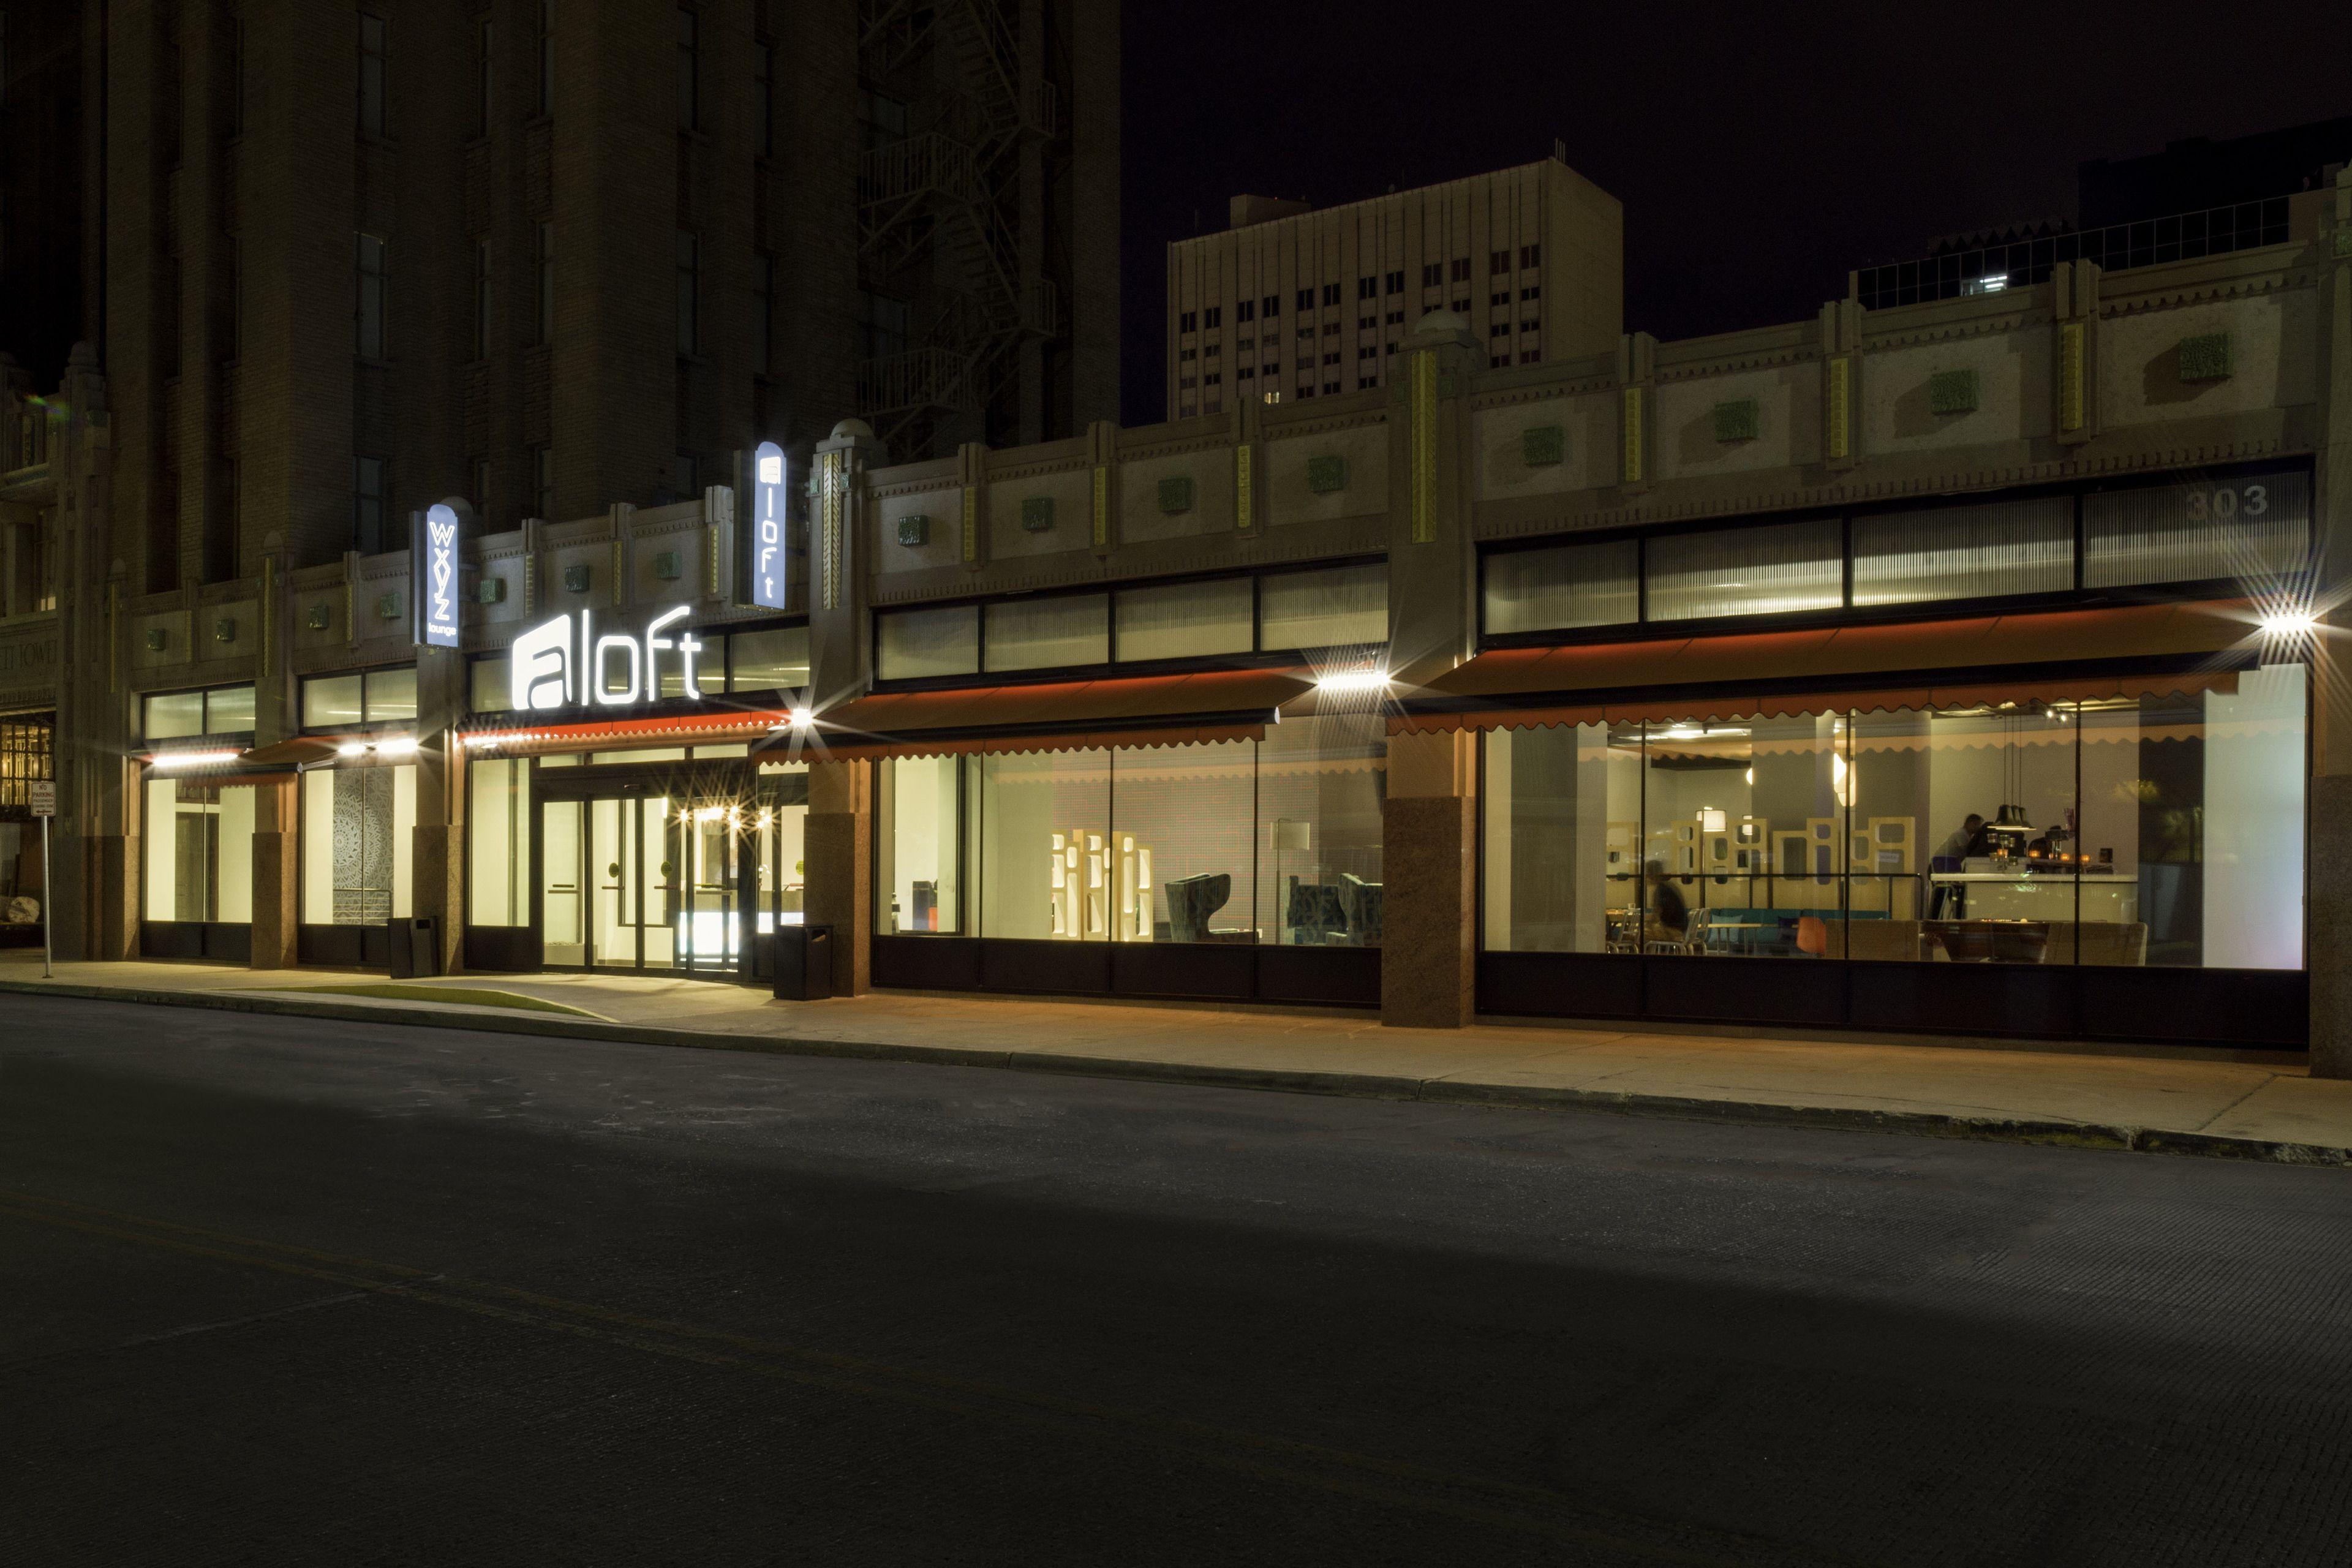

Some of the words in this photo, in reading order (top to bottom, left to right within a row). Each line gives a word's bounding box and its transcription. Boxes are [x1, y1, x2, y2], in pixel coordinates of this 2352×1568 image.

[760, 456, 781, 598] aloft
[2186, 485, 2267, 520] 303
[429, 522, 454, 620] wxyz
[18, 639, 58, 667] TOWE
[429, 622, 456, 636] lounge
[513, 606, 701, 710] aloft
